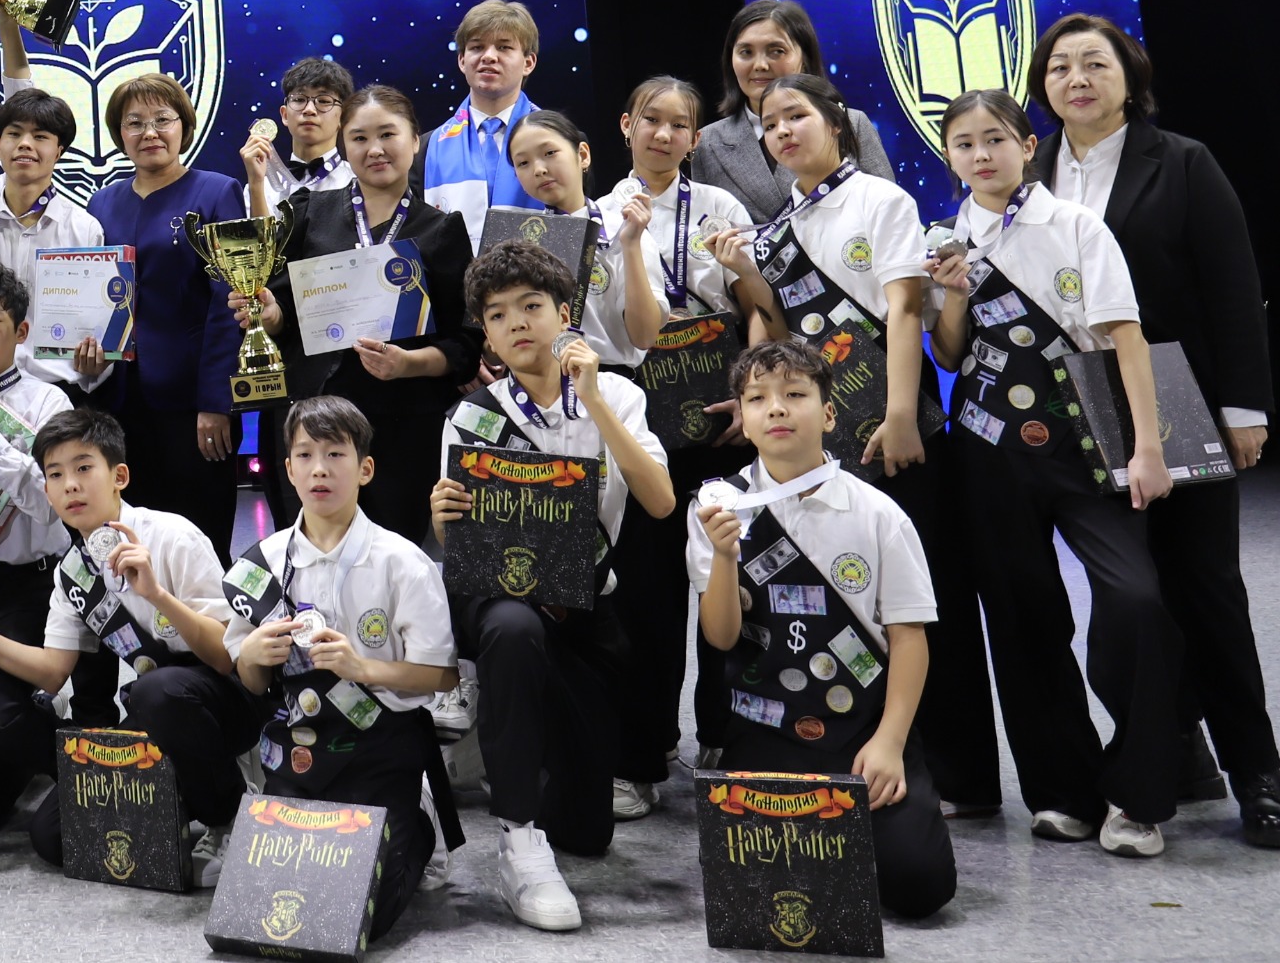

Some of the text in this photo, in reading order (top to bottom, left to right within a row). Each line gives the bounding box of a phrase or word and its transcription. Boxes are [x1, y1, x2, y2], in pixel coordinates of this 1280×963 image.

[42, 287, 78, 295] ДИПЛОМ
[303, 282, 348, 299] ДИПЛОМ
[656, 326, 702, 346] онополия
[641, 350, 723, 391] Harry Potter
[471, 487, 574, 527] Harry Potter
[787, 619, 807, 655] $
[75, 771, 156, 812] Harry Potter
[247, 832, 353, 873] Harry Potter
[726, 821, 846, 871] Harry Potter
